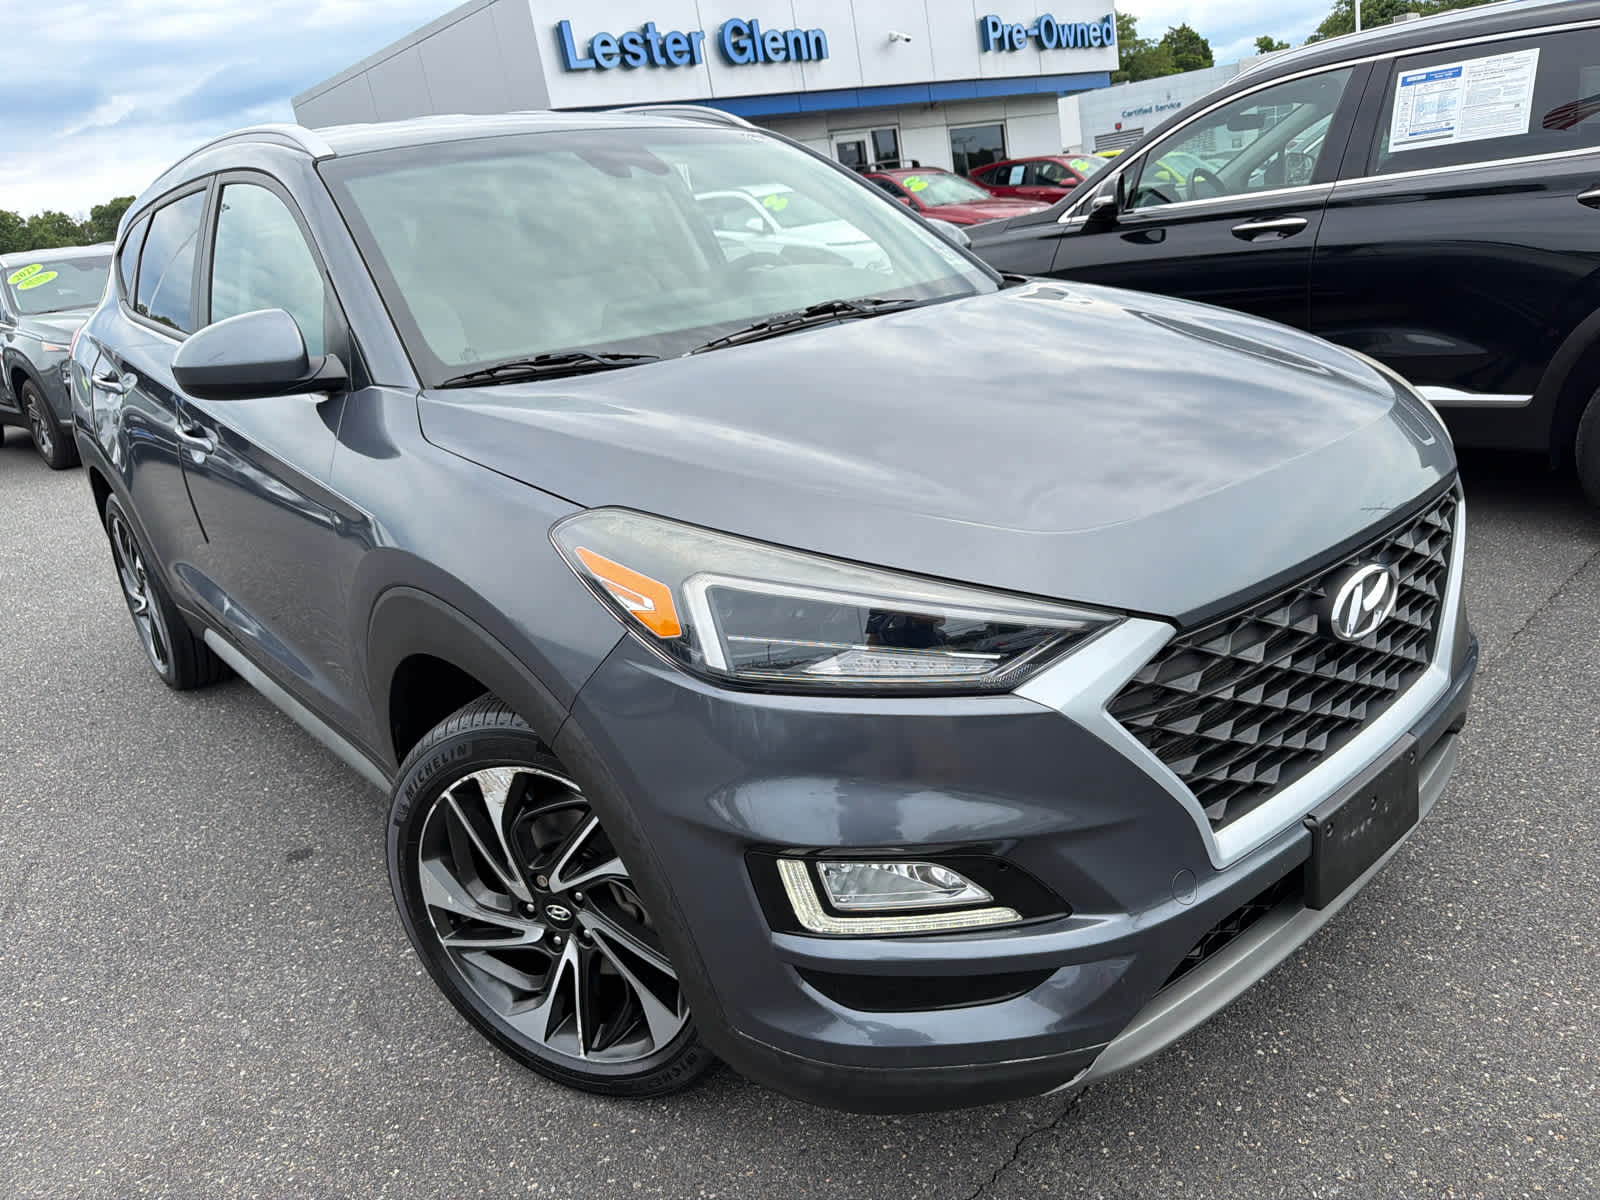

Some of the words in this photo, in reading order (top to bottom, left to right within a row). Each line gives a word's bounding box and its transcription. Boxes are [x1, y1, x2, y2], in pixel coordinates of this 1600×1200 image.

[556, 20, 705, 71] Lester
[719, 18, 829, 65] Glenn
[982, 13, 1115, 52] Pre-Owned
[1122, 106, 1153, 119] Certified
[1154, 102, 1181, 112] Service
[405, 744, 467, 800] MICHELIN
